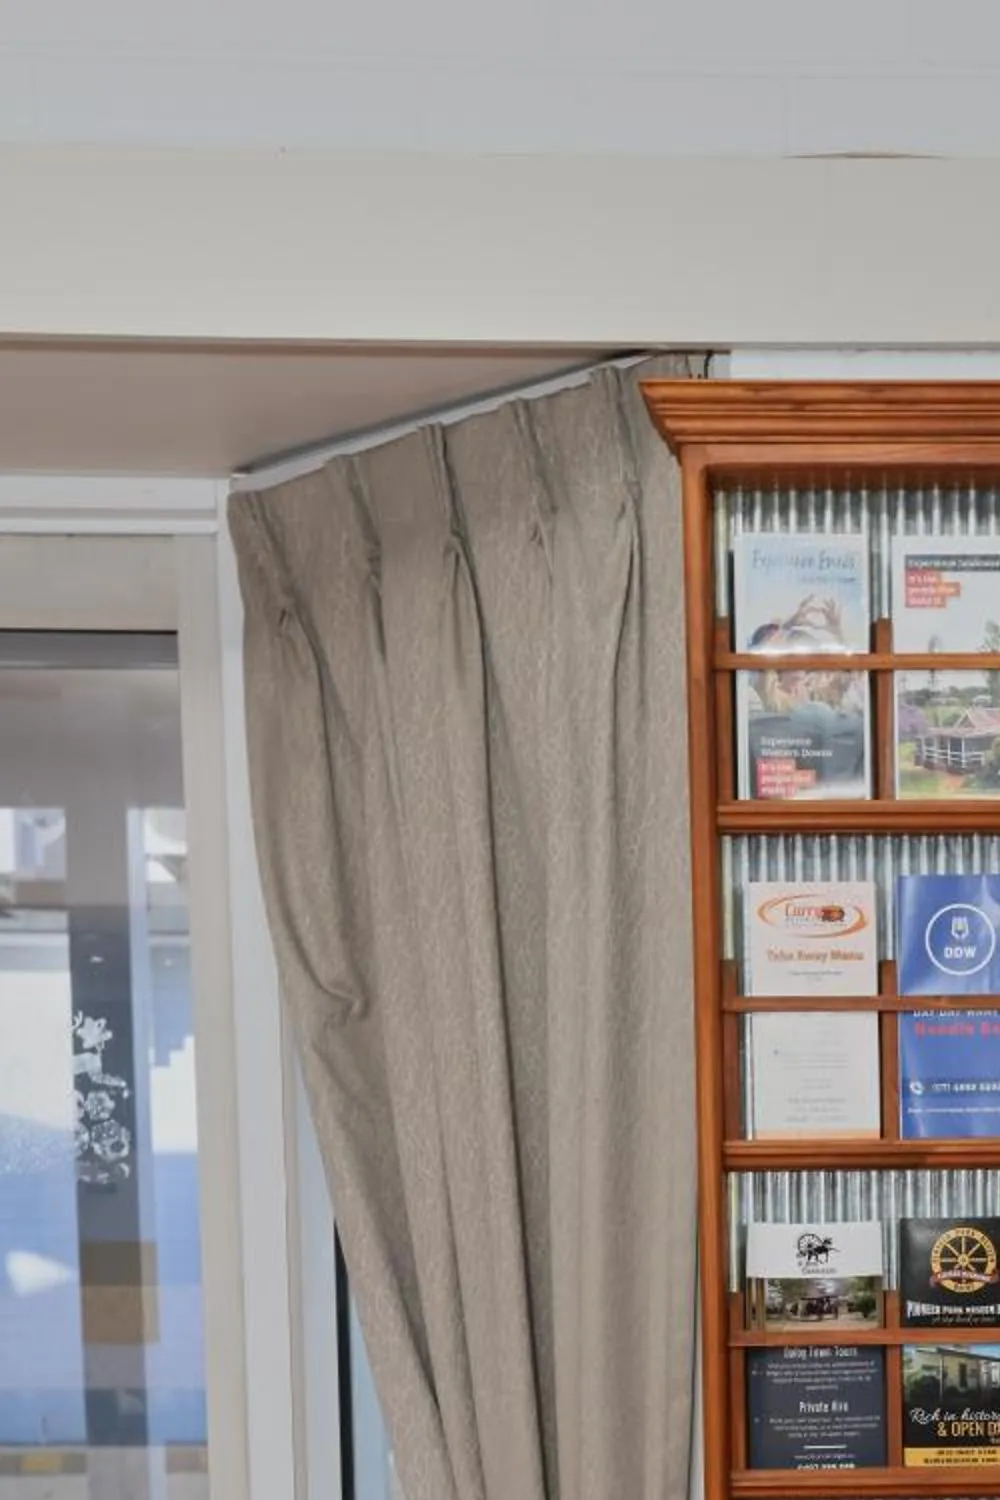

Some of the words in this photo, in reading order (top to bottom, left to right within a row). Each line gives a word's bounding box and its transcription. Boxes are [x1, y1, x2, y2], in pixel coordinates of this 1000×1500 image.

[768, 950, 794, 963] Take
[830, 948, 865, 962] Menu
[799, 1401, 829, 1413] Private
[909, 1407, 941, 1425] Rich
[943, 1410, 958, 1421] in
[937, 1421, 948, 1437] &
[951, 1421, 985, 1437] OPEN
